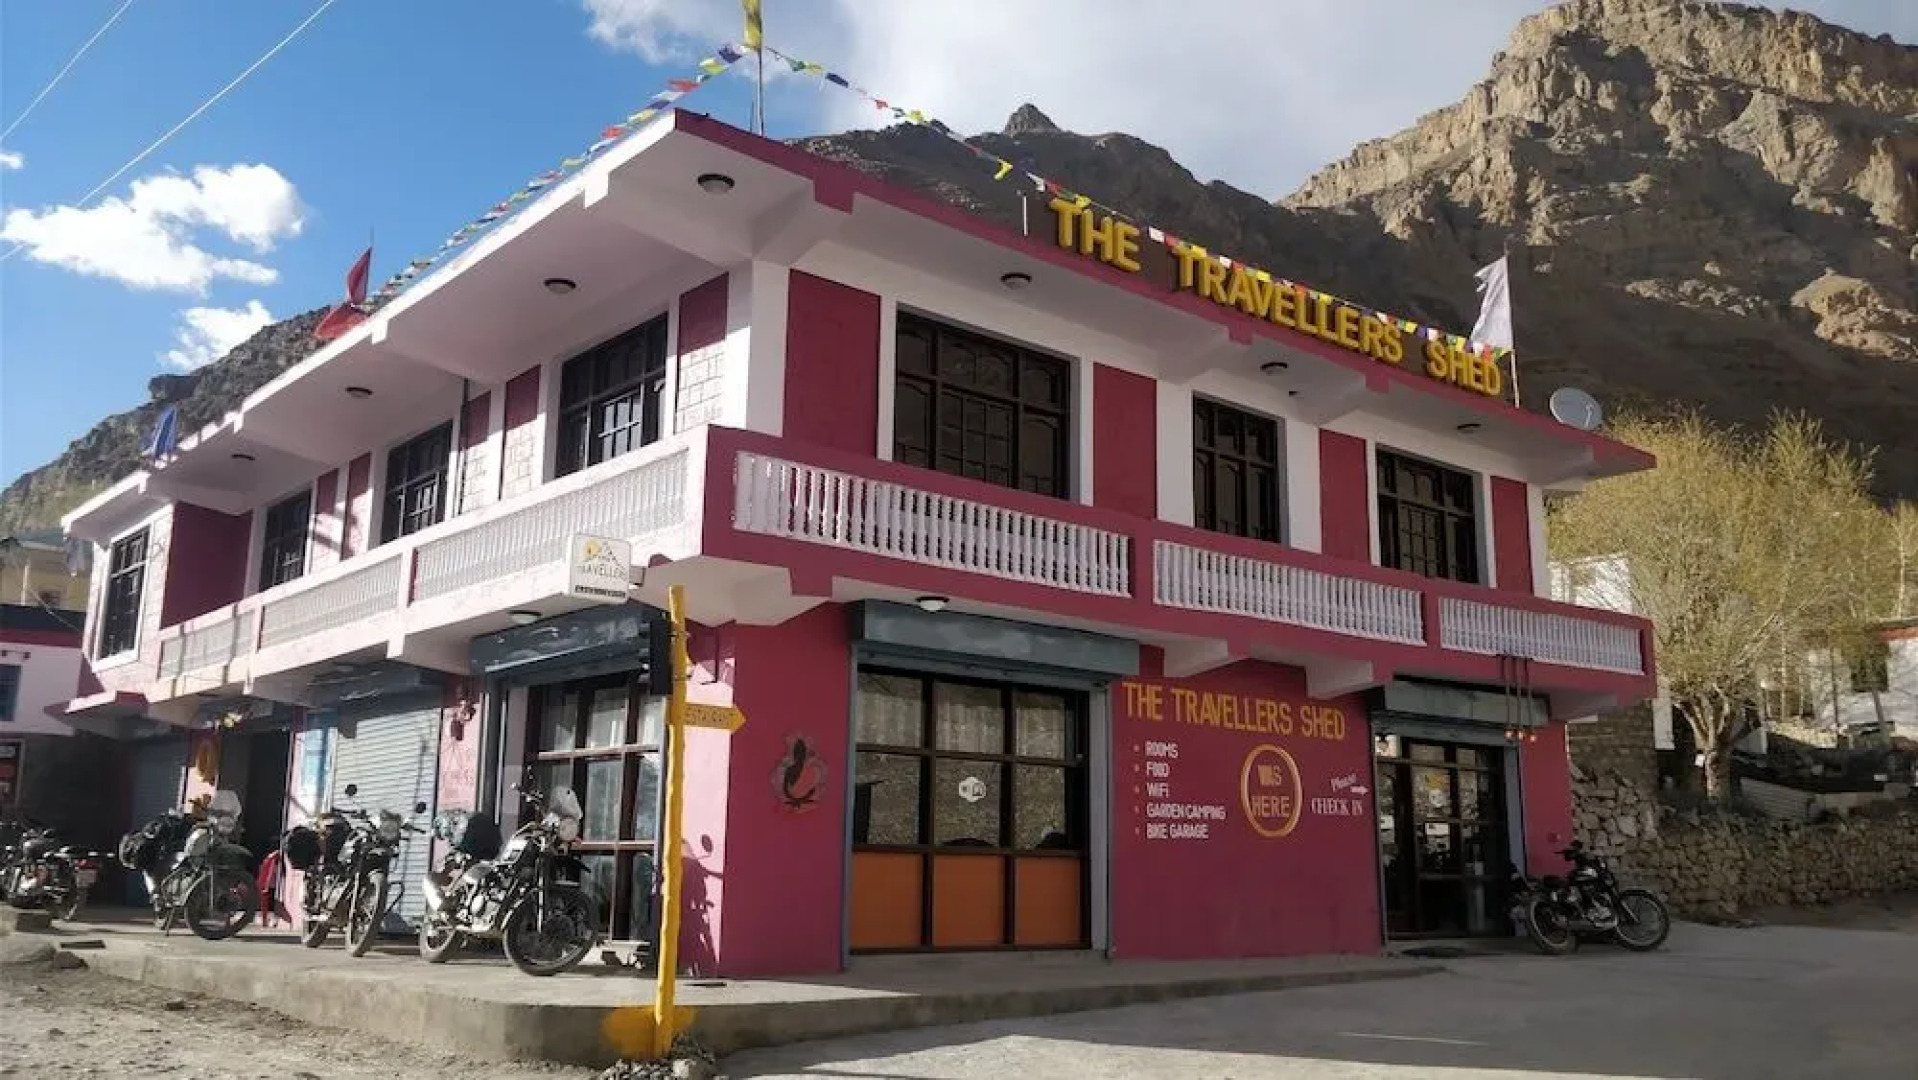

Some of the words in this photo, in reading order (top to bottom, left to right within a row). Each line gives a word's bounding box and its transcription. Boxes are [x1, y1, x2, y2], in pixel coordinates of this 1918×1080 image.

[1050, 197, 1142, 272] THE
[1170, 243, 1404, 364] TRAVELLERS
[1425, 338, 1501, 397] SHED
[1122, 681, 1163, 721] THE
[1171, 687, 1294, 736] TRAVELLERS
[1301, 705, 1345, 740] SHED
[1145, 740, 1178, 758] ROOMS
[1146, 761, 1169, 777] FOOD
[1146, 802, 1184, 819] GARDEN
[1185, 804, 1226, 820] CAMPING
[1251, 795, 1290, 818] HERE
[1311, 798, 1350, 816] CHECK
[1351, 798, 1363, 816] IN
[1146, 823, 1168, 839] BIKE
[1169, 823, 1209, 839] GARAGE
